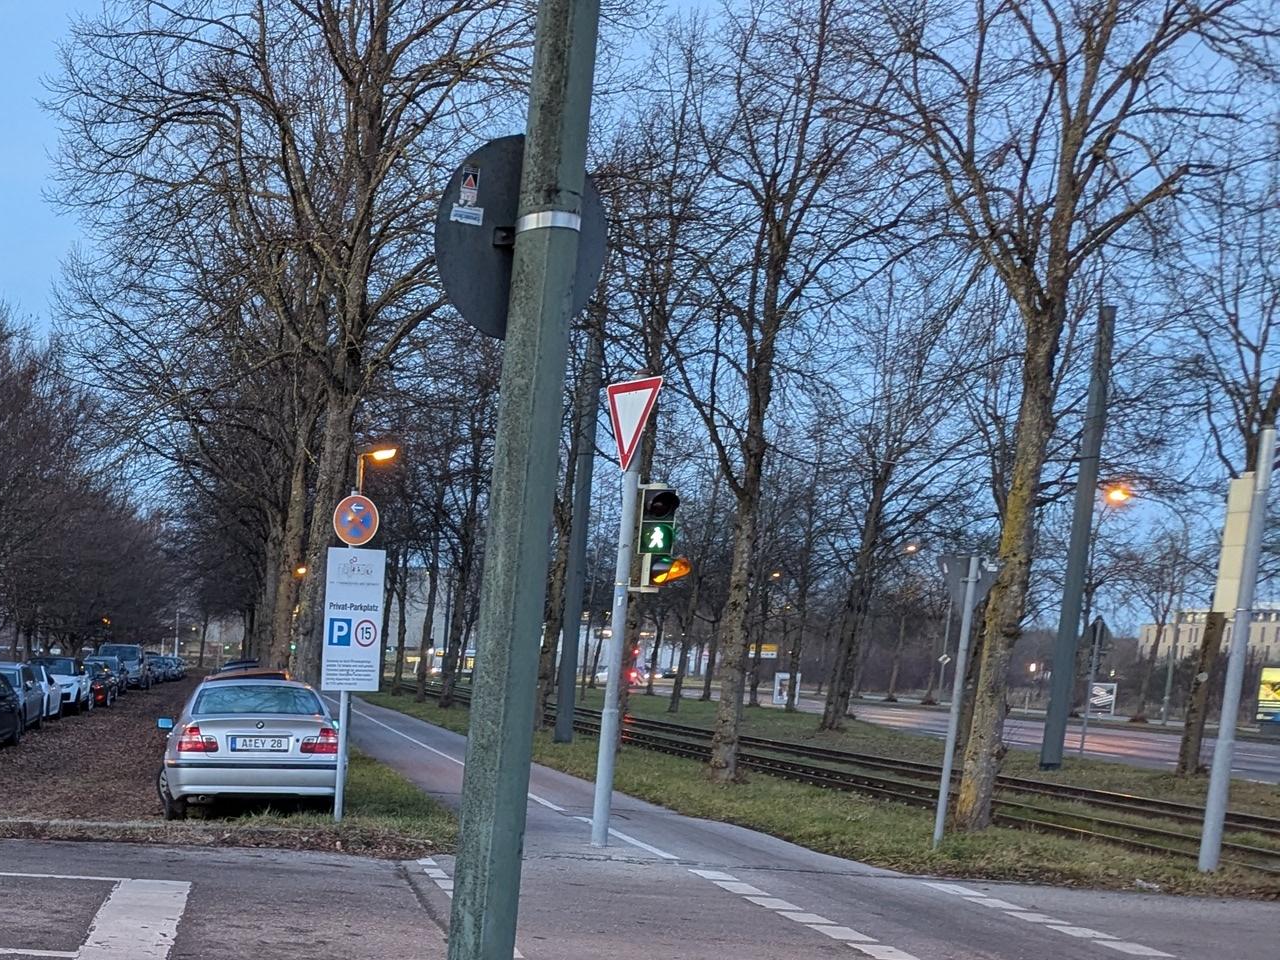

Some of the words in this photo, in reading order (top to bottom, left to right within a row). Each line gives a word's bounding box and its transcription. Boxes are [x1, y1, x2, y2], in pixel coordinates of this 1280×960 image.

[329, 602, 379, 612] Privat-Parkplatz
[332, 620, 348, 643] P
[360, 626, 372, 640] 15
[270, 739, 282, 748] 28
